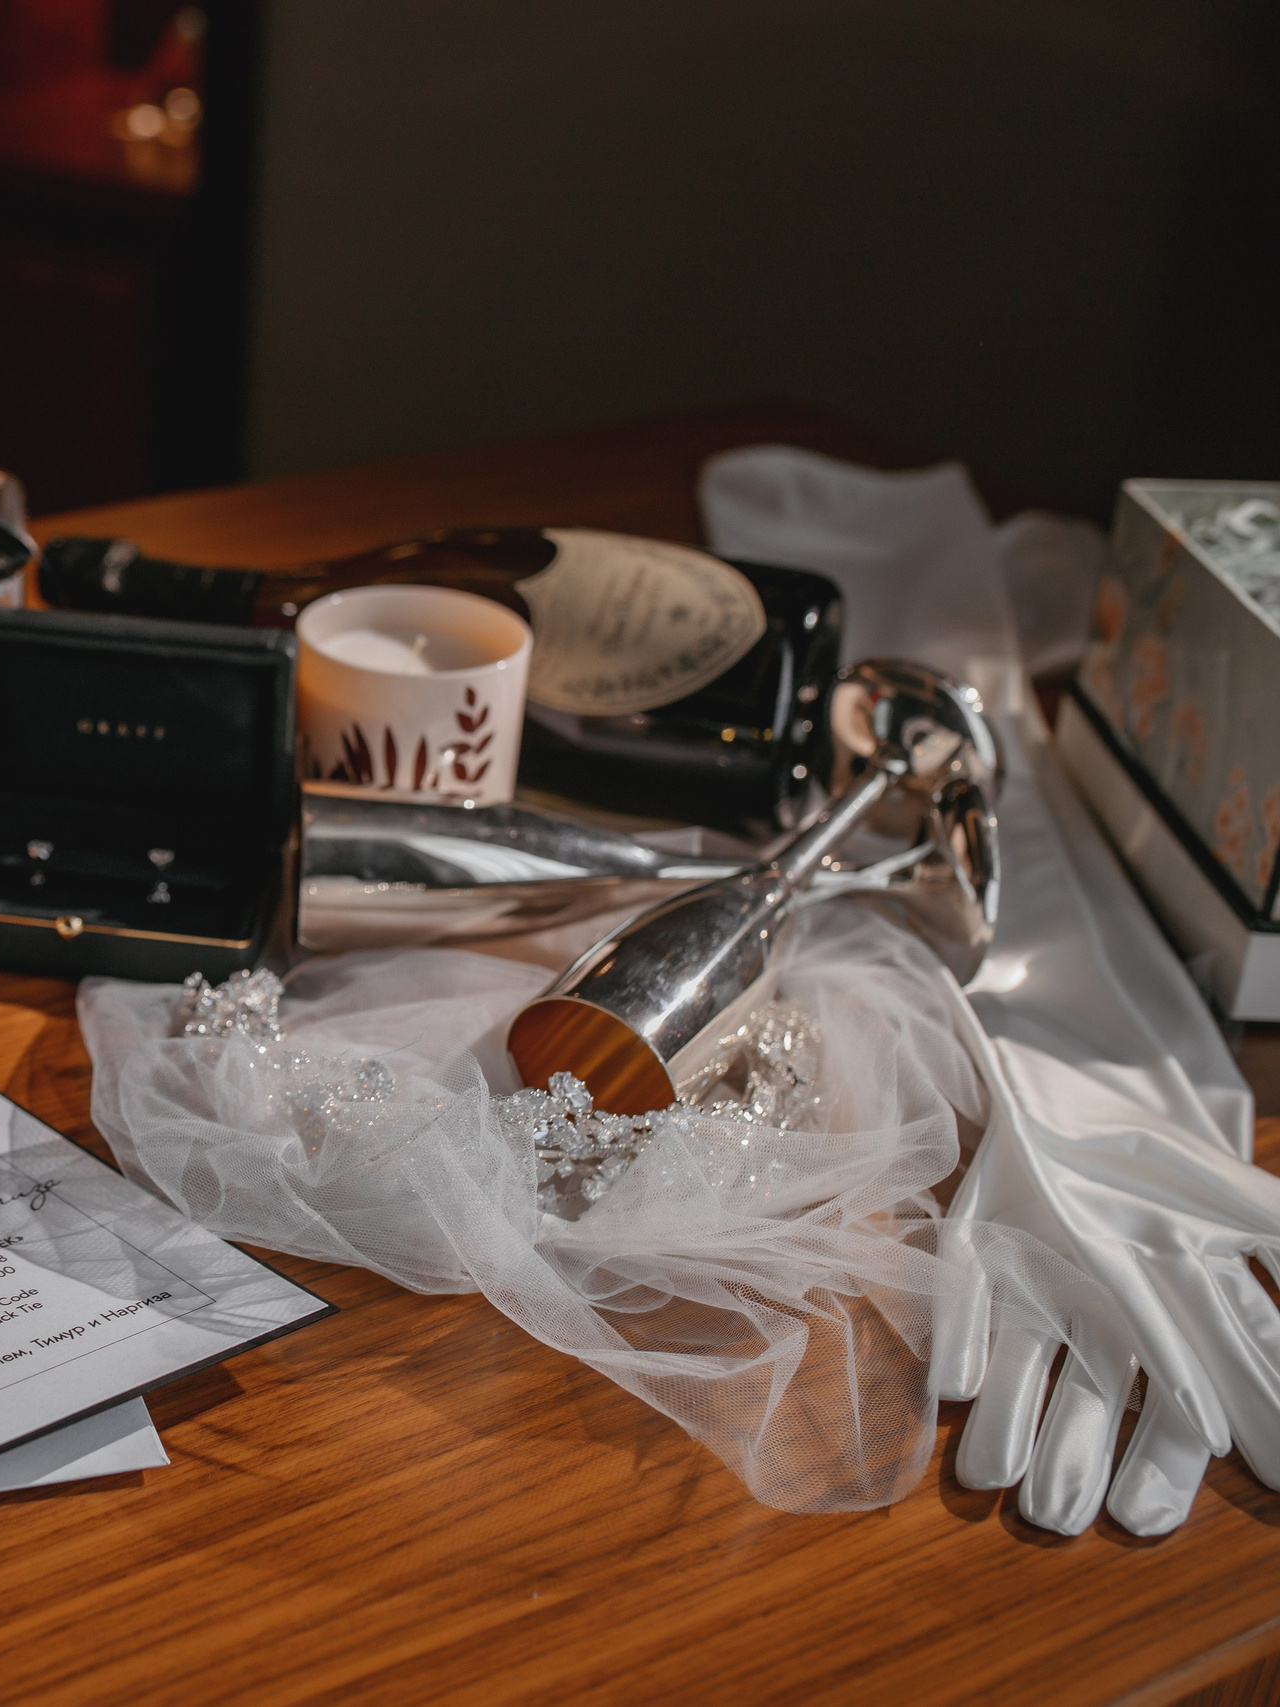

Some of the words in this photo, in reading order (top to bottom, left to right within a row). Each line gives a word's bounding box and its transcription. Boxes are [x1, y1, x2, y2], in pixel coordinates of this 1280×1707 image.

[17, 1300, 44, 1315] Tie
[30, 1323, 86, 1351] Тимур
[87, 1317, 102, 1329] и
[99, 1290, 173, 1323] Наргиза
